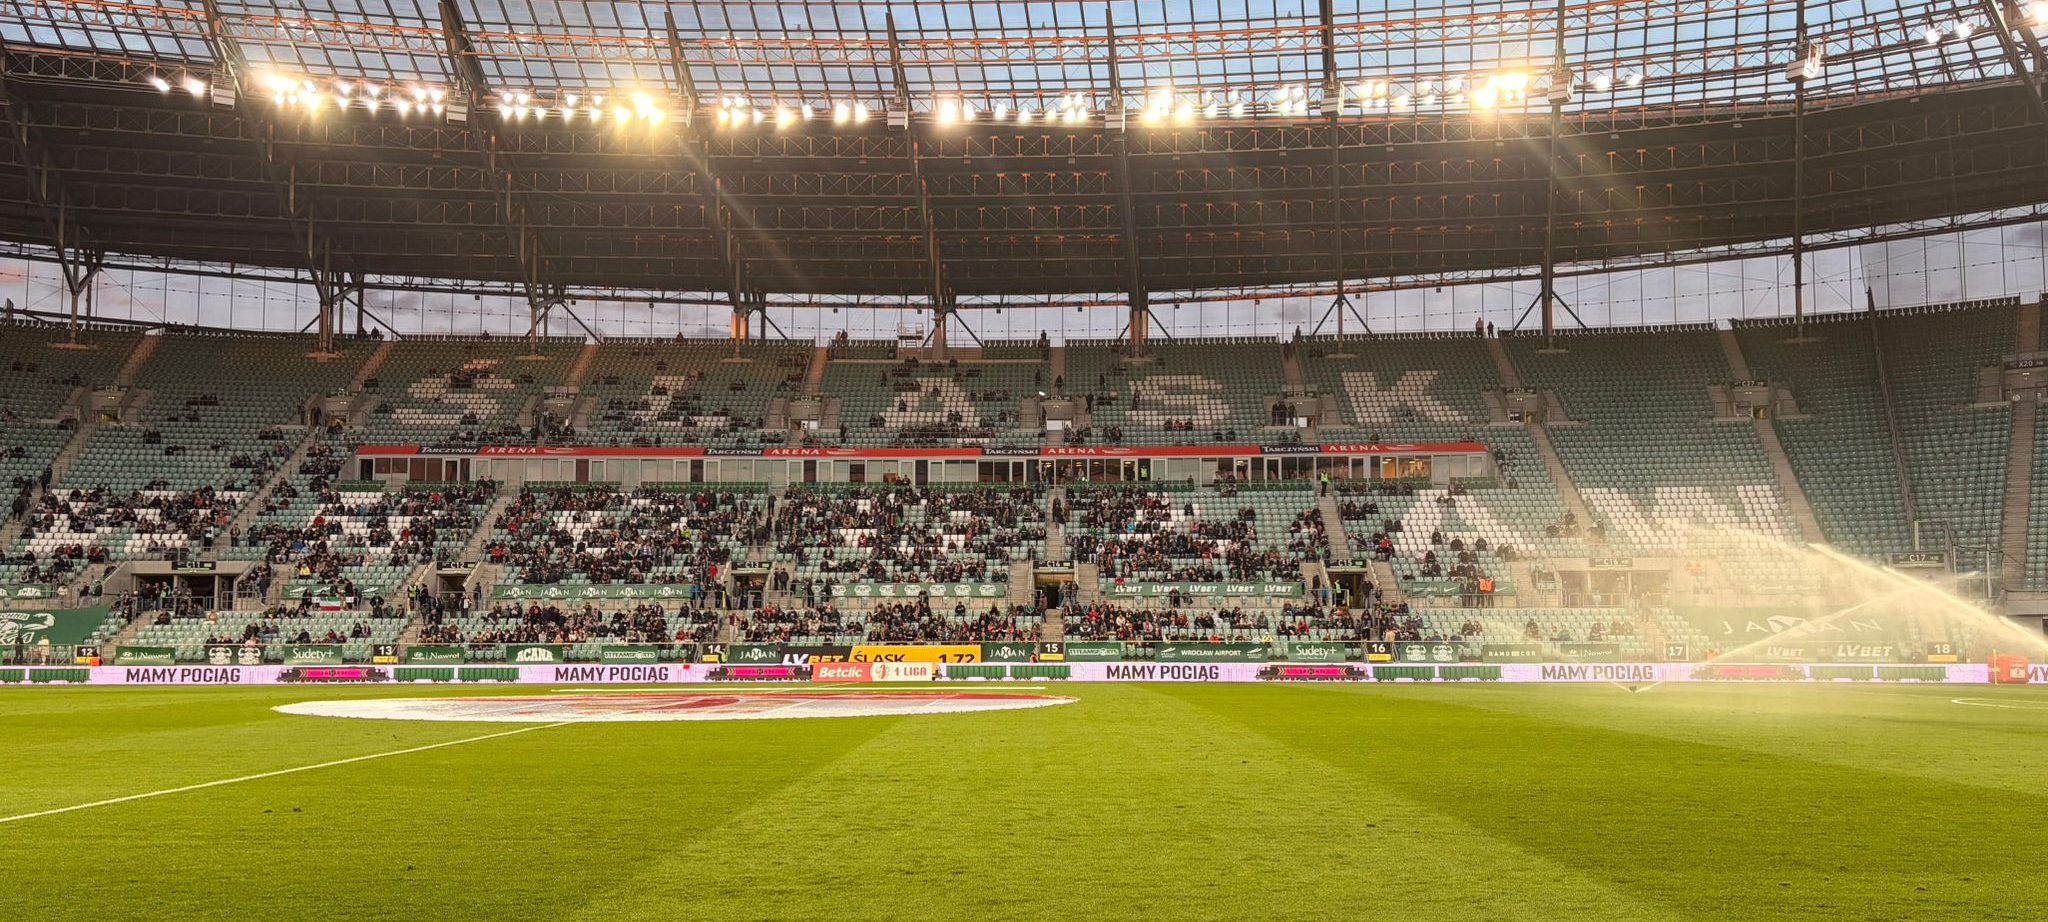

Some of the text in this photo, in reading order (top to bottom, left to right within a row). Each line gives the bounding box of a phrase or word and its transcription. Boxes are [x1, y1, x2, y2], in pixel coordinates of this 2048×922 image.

[1910, 554, 1925, 562] C17
[81, 648, 93, 656] 12
[379, 646, 392, 655] 13
[708, 645, 720, 654] 14
[1046, 644, 1058, 652] 15
[1296, 645, 1337, 659] Sudety+
[1372, 643, 1386, 653] 16
[1669, 646, 1683, 656] 17
[1934, 644, 1950, 654] 18
[139, 652, 171, 660] Nawrot
[293, 648, 334, 662] Sudety+
[429, 652, 460, 660] Nawrot
[516, 648, 554, 662] ACANA
[126, 668, 240, 684] MAMY POCIĄG
[555, 666, 669, 683] MAMY POCIĄG
[819, 666, 863, 678] Betclic
[904, 667, 927, 677] LIGA
[1107, 665, 1219, 682] MAMY POCIĄG
[1542, 666, 1588, 680] MAMY
